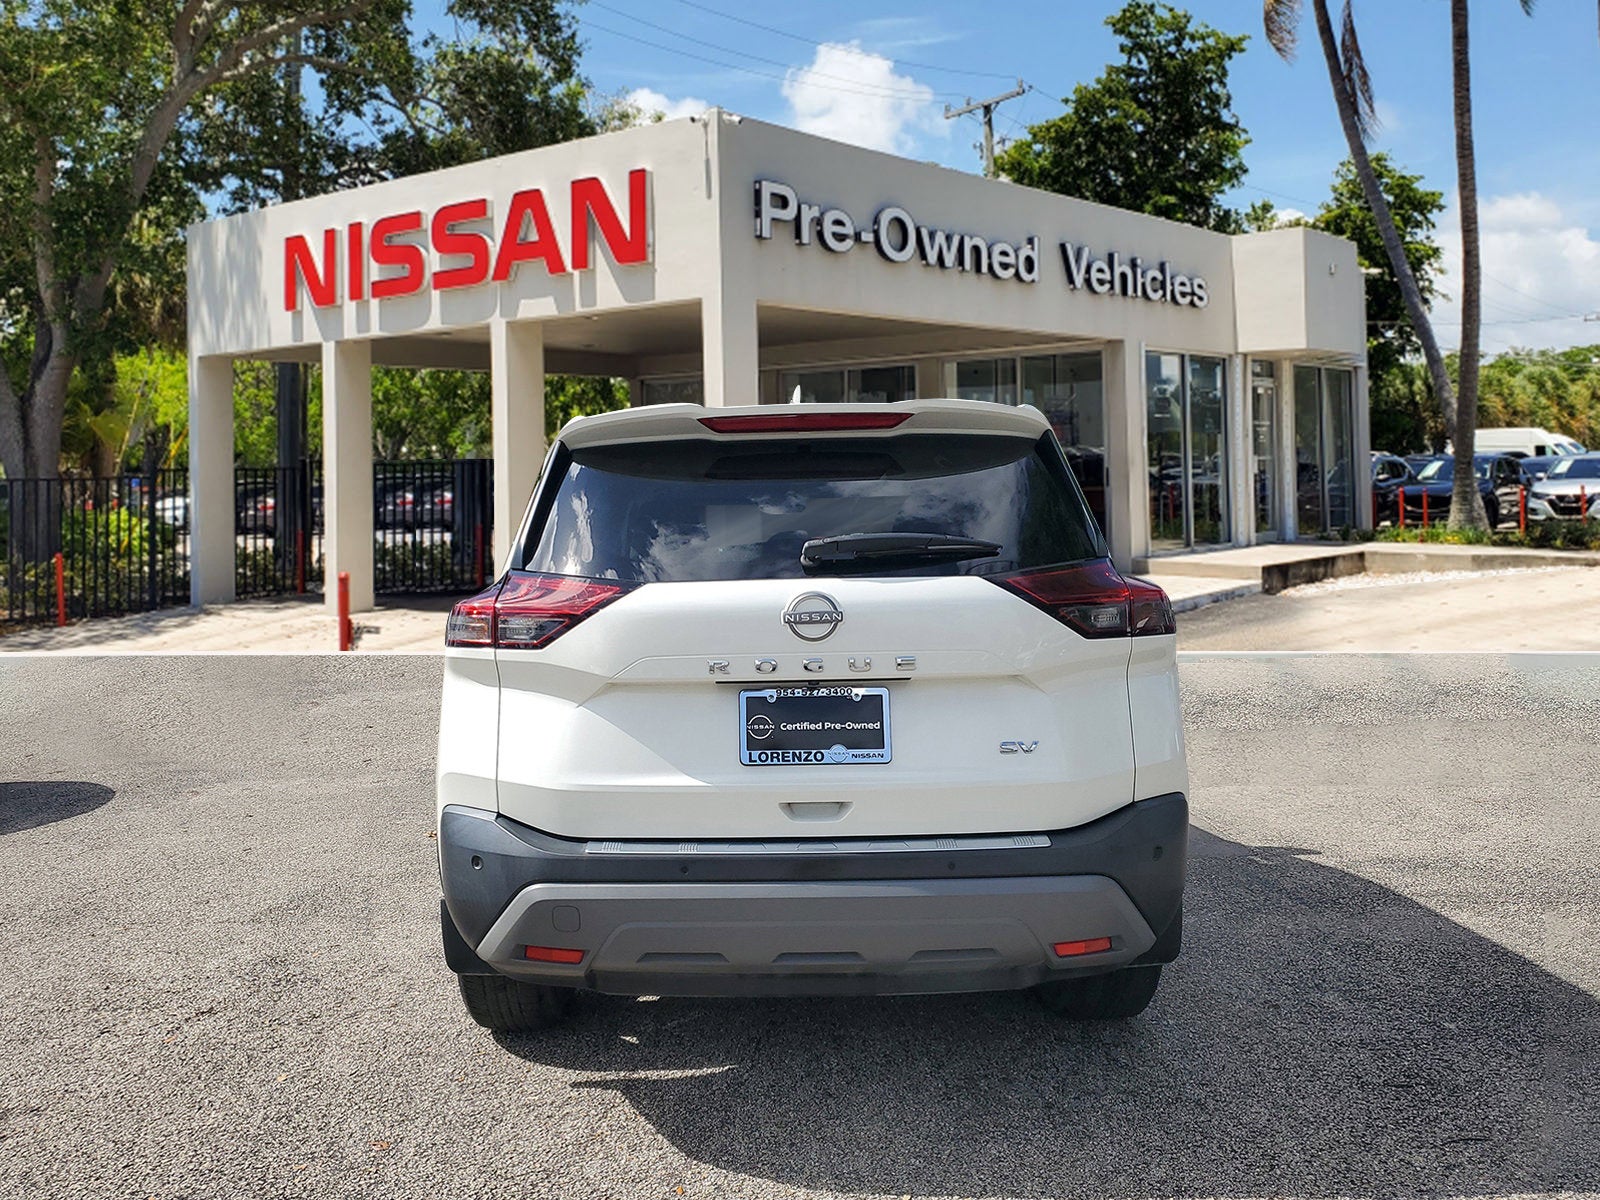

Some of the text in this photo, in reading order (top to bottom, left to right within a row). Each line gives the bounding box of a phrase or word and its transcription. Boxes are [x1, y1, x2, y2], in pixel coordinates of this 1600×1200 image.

[284, 168, 648, 312] NISSAN
[754, 179, 1208, 309] Pre-Owned Vehicles
[785, 612, 842, 622] NISSAN
[707, 656, 917, 675] ROGUE
[776, 688, 853, 697] 954-527-3400
[780, 721, 881, 731] Certified Pre-Owned
[1000, 740, 1039, 755] SV
[748, 751, 825, 763] LORENZO
